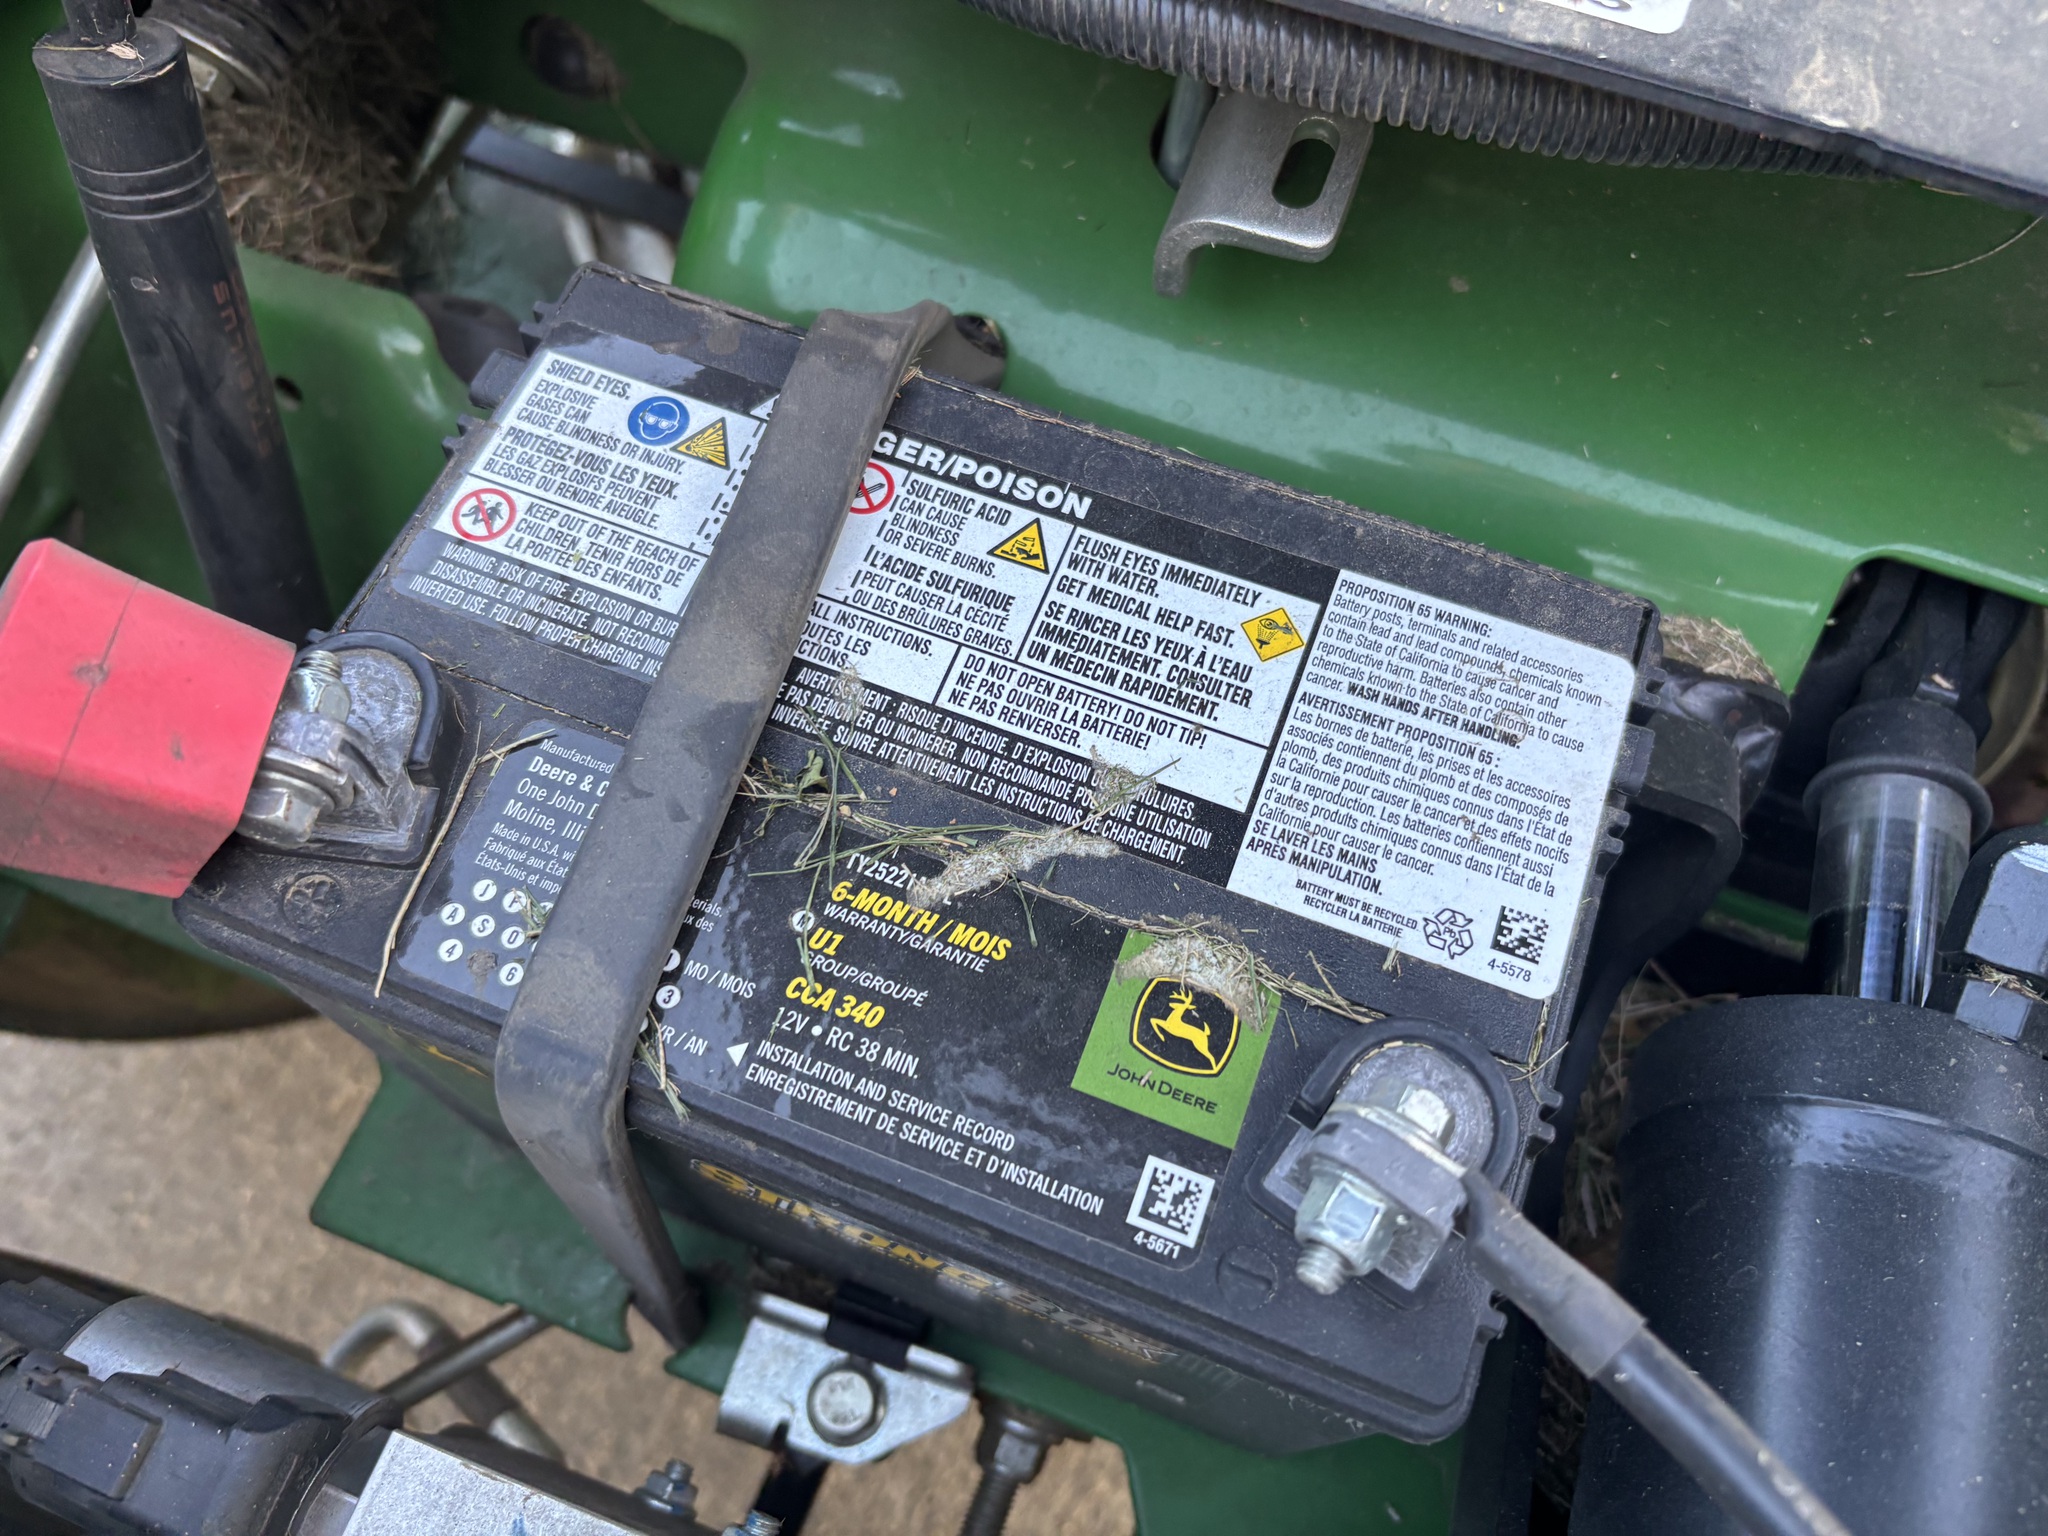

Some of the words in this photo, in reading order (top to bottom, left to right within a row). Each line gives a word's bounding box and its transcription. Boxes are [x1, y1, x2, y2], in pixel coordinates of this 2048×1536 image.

[525, 393, 565, 415] GASES
[563, 405, 591, 424] CAN
[534, 378, 599, 409] EXPLOSIVE
[546, 359, 595, 385] SHIELD
[592, 374, 631, 400] EYES.
[501, 425, 612, 475] PROTÉGEZ-VOUS
[609, 462, 639, 484] LES
[638, 471, 679, 500] YEUX.
[516, 407, 557, 430] CAUSE
[554, 420, 621, 451] BLINDNESS
[619, 441, 640, 459] OR
[638, 447, 685, 475] INJURY.
[482, 457, 536, 486] BLESSER
[535, 475, 556, 492] OU
[553, 481, 605, 509] RENDRE
[601, 499, 659, 530] AVEUGLE.
[491, 442, 517, 461] LES
[515, 451, 543, 470] GAZ
[539, 459, 605, 491] EXPLOSIFS
[603, 480, 661, 510] PEUVENT
[873, 431, 1092, 519] GER/POISON
[906, 478, 975, 514] SULFURIC
[974, 502, 1011, 526] ACID
[524, 501, 560, 523] KEEP
[557, 513, 588, 533] OUT
[586, 523, 608, 540] OF
[606, 529, 634, 550] THE
[631, 539, 679, 566] REACH
[677, 554, 700, 571] OF
[890, 512, 960, 546] BLINDNESS
[898, 497, 926, 516] CAN
[925, 506, 968, 530] CAUSE
[504, 533, 524, 551] LA
[522, 539, 577, 568] PORTÉE
[572, 557, 602, 578] DES
[600, 567, 662, 601] ENFANTS.
[585, 541, 625, 567] TENIR
[623, 555, 663, 580] HORS
[662, 568, 685, 587] DE
[869, 550, 927, 582] L'ACIDE
[925, 570, 1015, 613] SULFURIQUE
[883, 528, 903, 546] OR
[903, 535, 952, 562] SEVERE
[950, 550, 995, 578] BURNS.
[1066, 552, 1106, 579] WITH
[1106, 565, 1159, 598] WATER.
[1073, 534, 1121, 563] FLUSH
[1120, 549, 1160, 576] EYES
[1160, 562, 1262, 608] IMMEDIATELY
[852, 589, 873, 606] OU
[871, 595, 898, 616] DES
[896, 604, 963, 638] BRÛLURES
[963, 626, 1012, 656] GRAVES.
[860, 570, 896, 593] PEUT
[894, 582, 945, 611] CAUSER
[945, 599, 963, 616] LA
[963, 606, 1009, 632] CÉCITÉ
[1056, 574, 1088, 598] GET
[1086, 584, 1151, 621] MEDICAL
[1153, 606, 1193, 632] HELP
[1193, 619, 1235, 648] FAST.
[1338, 579, 1416, 613] PROPOSITION
[1417, 603, 1432, 618] 65
[1434, 608, 1492, 636] WARNING:
[1035, 618, 1168, 678] IMMÉDIATEMENT.
[1166, 664, 1252, 708] CONSULTER
[1044, 600, 1066, 621] SE
[1065, 607, 1121, 640] RINCER
[1121, 626, 1151, 649] LES
[1153, 635, 1194, 664] YEUX
[1192, 645, 1207, 669] À
[1207, 654, 1253, 683] L'EAU
[1333, 593, 1371, 617] Battery
[1370, 608, 1403, 629] posts,
[1407, 617, 1457, 643] terminals
[1458, 636, 1480, 651] and
[1481, 643, 1519, 663] related
[1519, 655, 1583, 683] accessories
[955, 671, 977, 690] NE
[976, 678, 1005, 699] PAS
[1006, 688, 1059, 719] OUVRIR
[1059, 706, 1079, 726] LA
[1079, 713, 1151, 750] BATTERIE!
[963, 653, 985, 672] DO
[985, 661, 1017, 683] NOT
[1016, 672, 1055, 697] OPEN
[1055, 685, 1122, 720] BATTERY!
[1122, 708, 1144, 727] DO
[1145, 715, 1177, 738] NOT
[1178, 726, 1207, 749] TIP!
[1026, 641, 1051, 663] UN
[1049, 645, 1124, 687] MÉDECIN
[1120, 673, 1219, 721] RAPIDEMENT.
[1305, 671, 1343, 690] cancer.
[1347, 681, 1380, 703] WASH
[1381, 692, 1420, 715] HANDS
[1420, 706, 1459, 728] AFTER
[1459, 718, 1519, 749] HANDLING.
[539, 738, 614, 773] Manufactured
[1297, 691, 1395, 732] AVERTISSEMENT
[1395, 722, 1476, 759] PROPOSITION
[1478, 749, 1493, 765] 65
[517, 777, 547, 801] One
[546, 789, 585, 815] John
[527, 755, 577, 785] Deere
[579, 774, 593, 792] &
[502, 798, 555, 835] Moline,
[1252, 819, 1270, 836] SE
[1270, 825, 1309, 850] LAVER
[1310, 839, 1335, 858] LES
[1336, 848, 1377, 873] MAINS
[1245, 836, 1287, 861] APRÈS
[1288, 850, 1382, 895] MANIPULATION.
[1295, 878, 1334, 899] BATTERY
[1334, 892, 1358, 908] MUST
[1360, 901, 1373, 913] BE
[809, 928, 843, 955] U1
[823, 902, 989, 973] WARRANTY/GARANTIE
[832, 881, 939, 933] 6-MONTH
[948, 923, 1011, 960] MOIS
[1303, 894, 1347, 918] RECYCLER
[1348, 910, 1359, 923] LA
[1361, 915, 1403, 938] BATTERIE
[1442, 926, 1456, 938] Pb
[1487, 958, 1531, 982] 4-5578
[786, 977, 836, 1011] CCA
[835, 995, 885, 1028] 340
[771, 1006, 810, 1034] 12V
[825, 1026, 853, 1051] RC
[854, 1037, 880, 1062] 38
[880, 1047, 919, 1079] MIN.
[756, 1039, 855, 1090] INSTALLATION
[853, 1077, 886, 1101] AND
[887, 1089, 952, 1127] SERVICE
[952, 1114, 1015, 1151] RECORD
[1106, 1063, 1156, 1091] JOHN
[1157, 1080, 1217, 1114] DEERE
[744, 1062, 876, 1125] ENREGISTREMENT
[875, 1112, 899, 1135] DE
[898, 1121, 964, 1160] SERVICE
[964, 1146, 986, 1168] ET
[985, 1155, 1104, 1215] D'INSTALLATION
[1133, 1230, 1180, 1259] 4-5671
